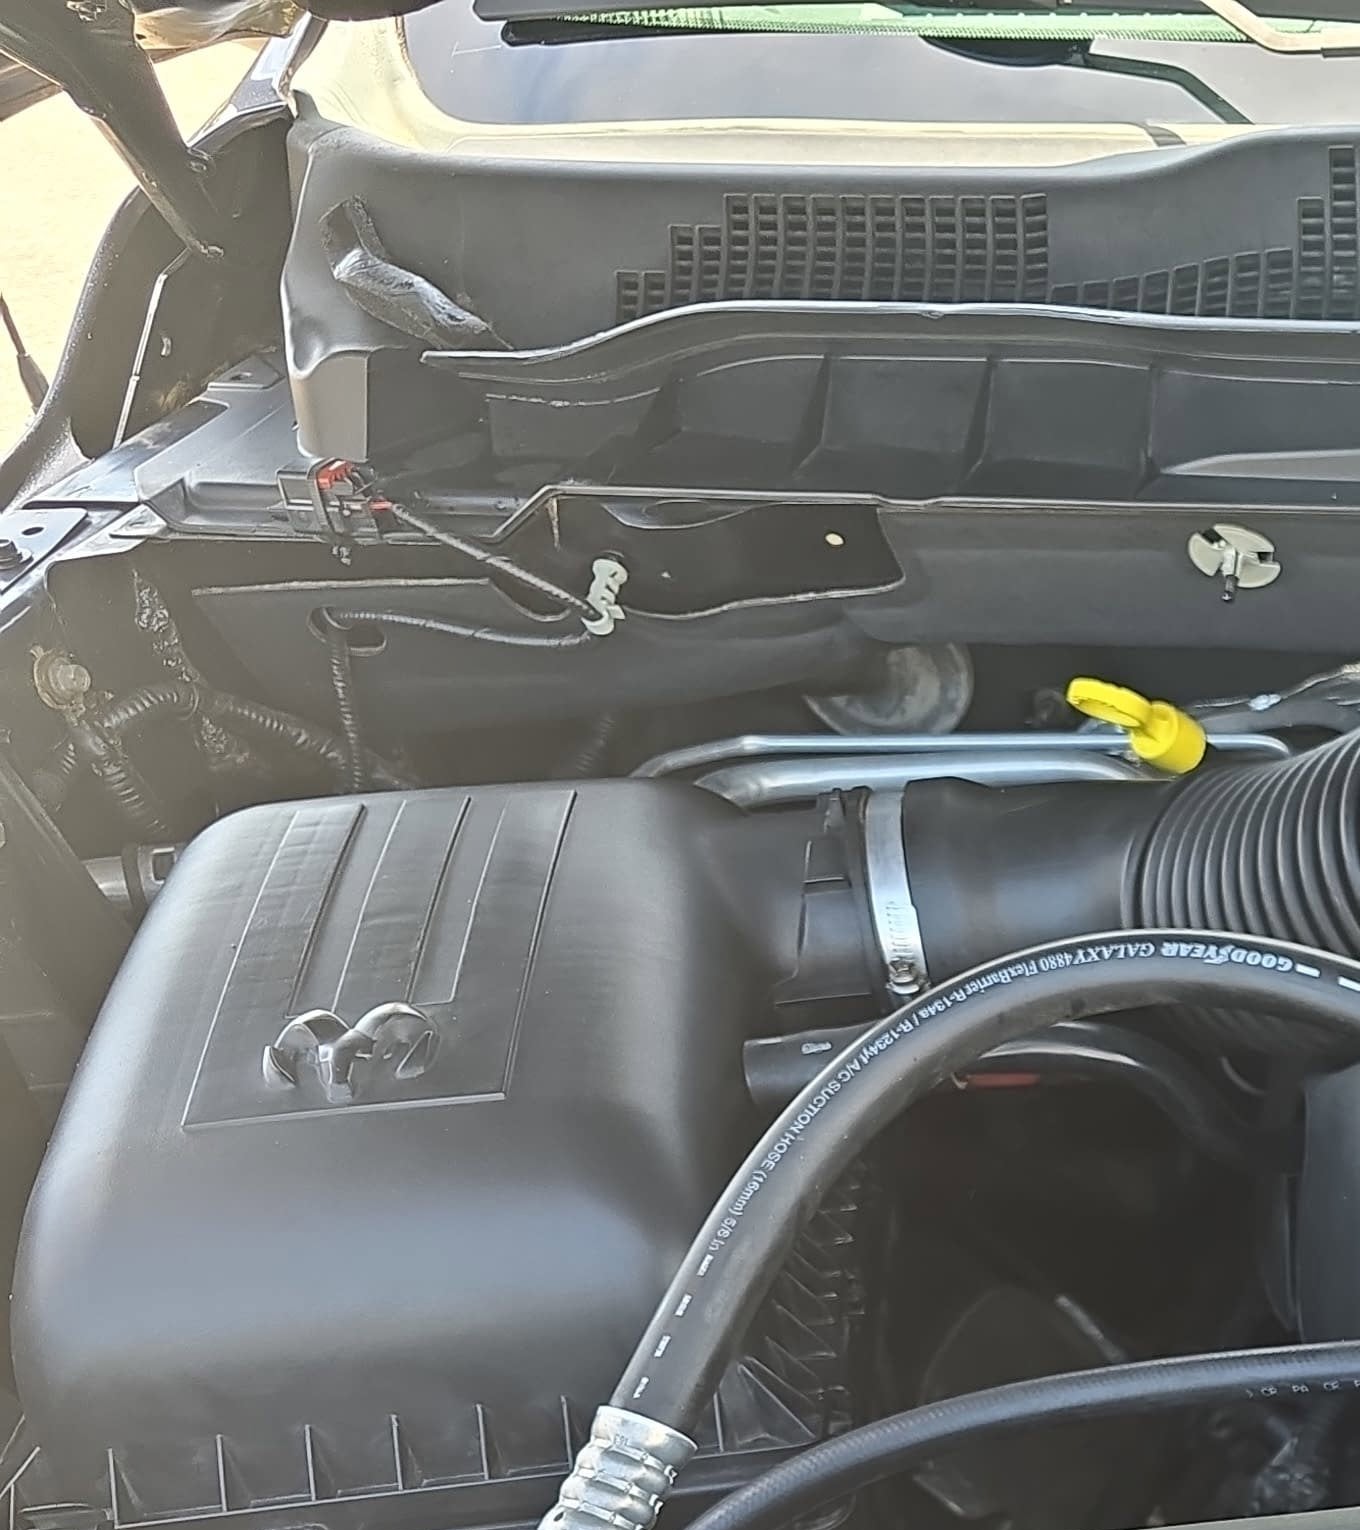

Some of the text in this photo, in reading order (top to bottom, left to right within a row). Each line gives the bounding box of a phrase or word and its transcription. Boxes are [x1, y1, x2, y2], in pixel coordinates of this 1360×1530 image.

[1161, 942, 1294, 972] GOODYEAR
[837, 1059, 863, 1083] A/C
[790, 1080, 842, 1134] SUCTION
[760, 1131, 797, 1171] HOSE
[728, 1169, 768, 1216] (16mm)
